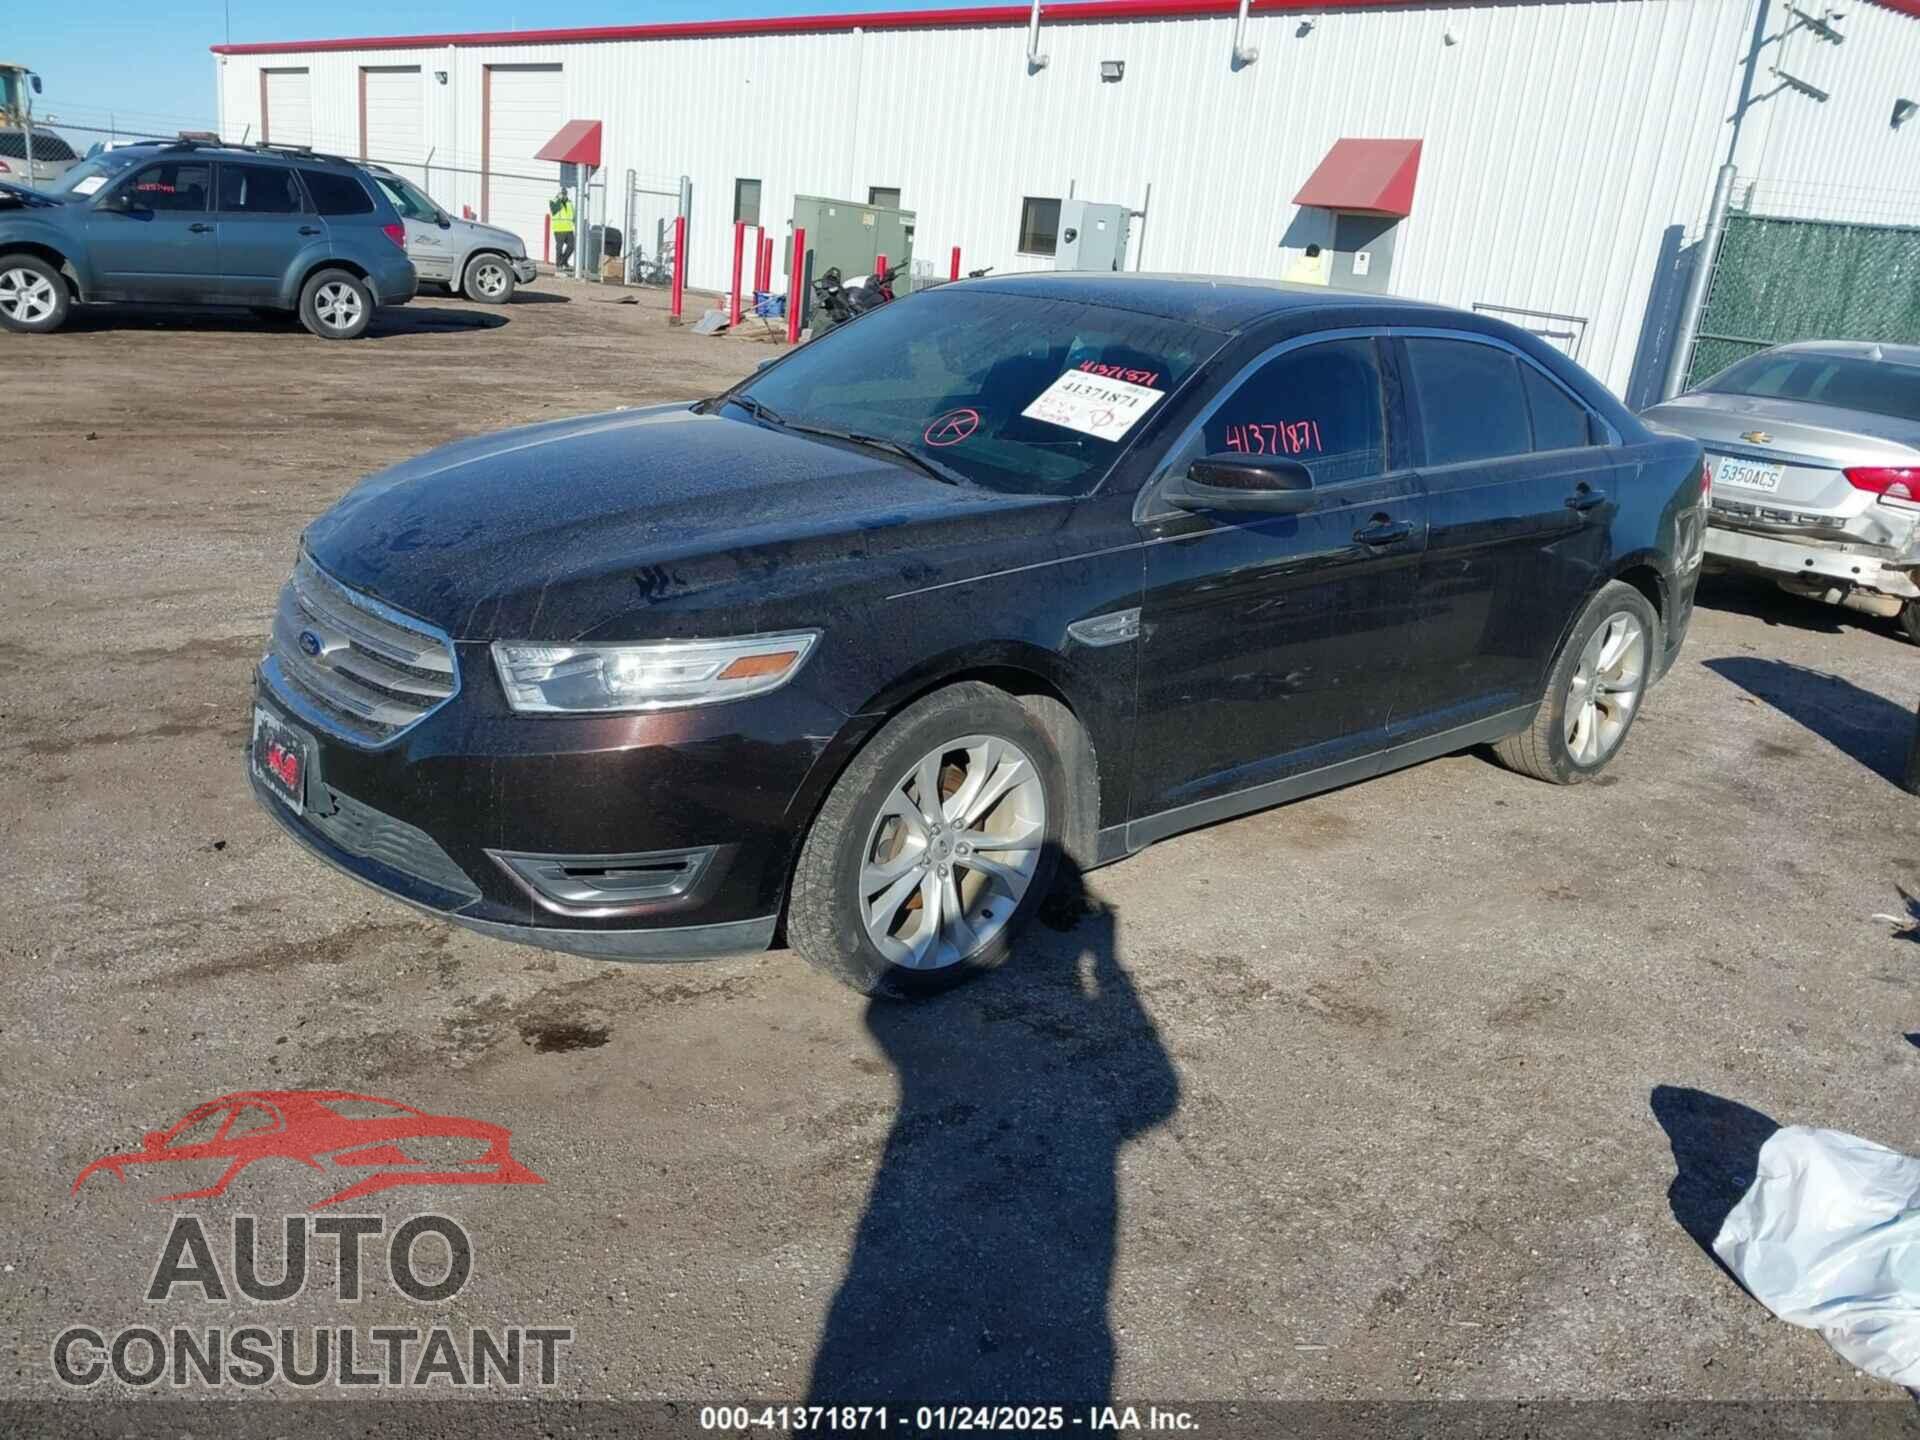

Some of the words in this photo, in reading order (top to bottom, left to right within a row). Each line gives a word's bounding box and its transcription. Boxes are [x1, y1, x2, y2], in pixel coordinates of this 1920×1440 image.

[1079, 360, 1159, 387] 41371871
[1062, 382, 1139, 408] 41371871
[1226, 420, 1322, 455] 41371871
[1720, 464, 1779, 487] 5350ACS
